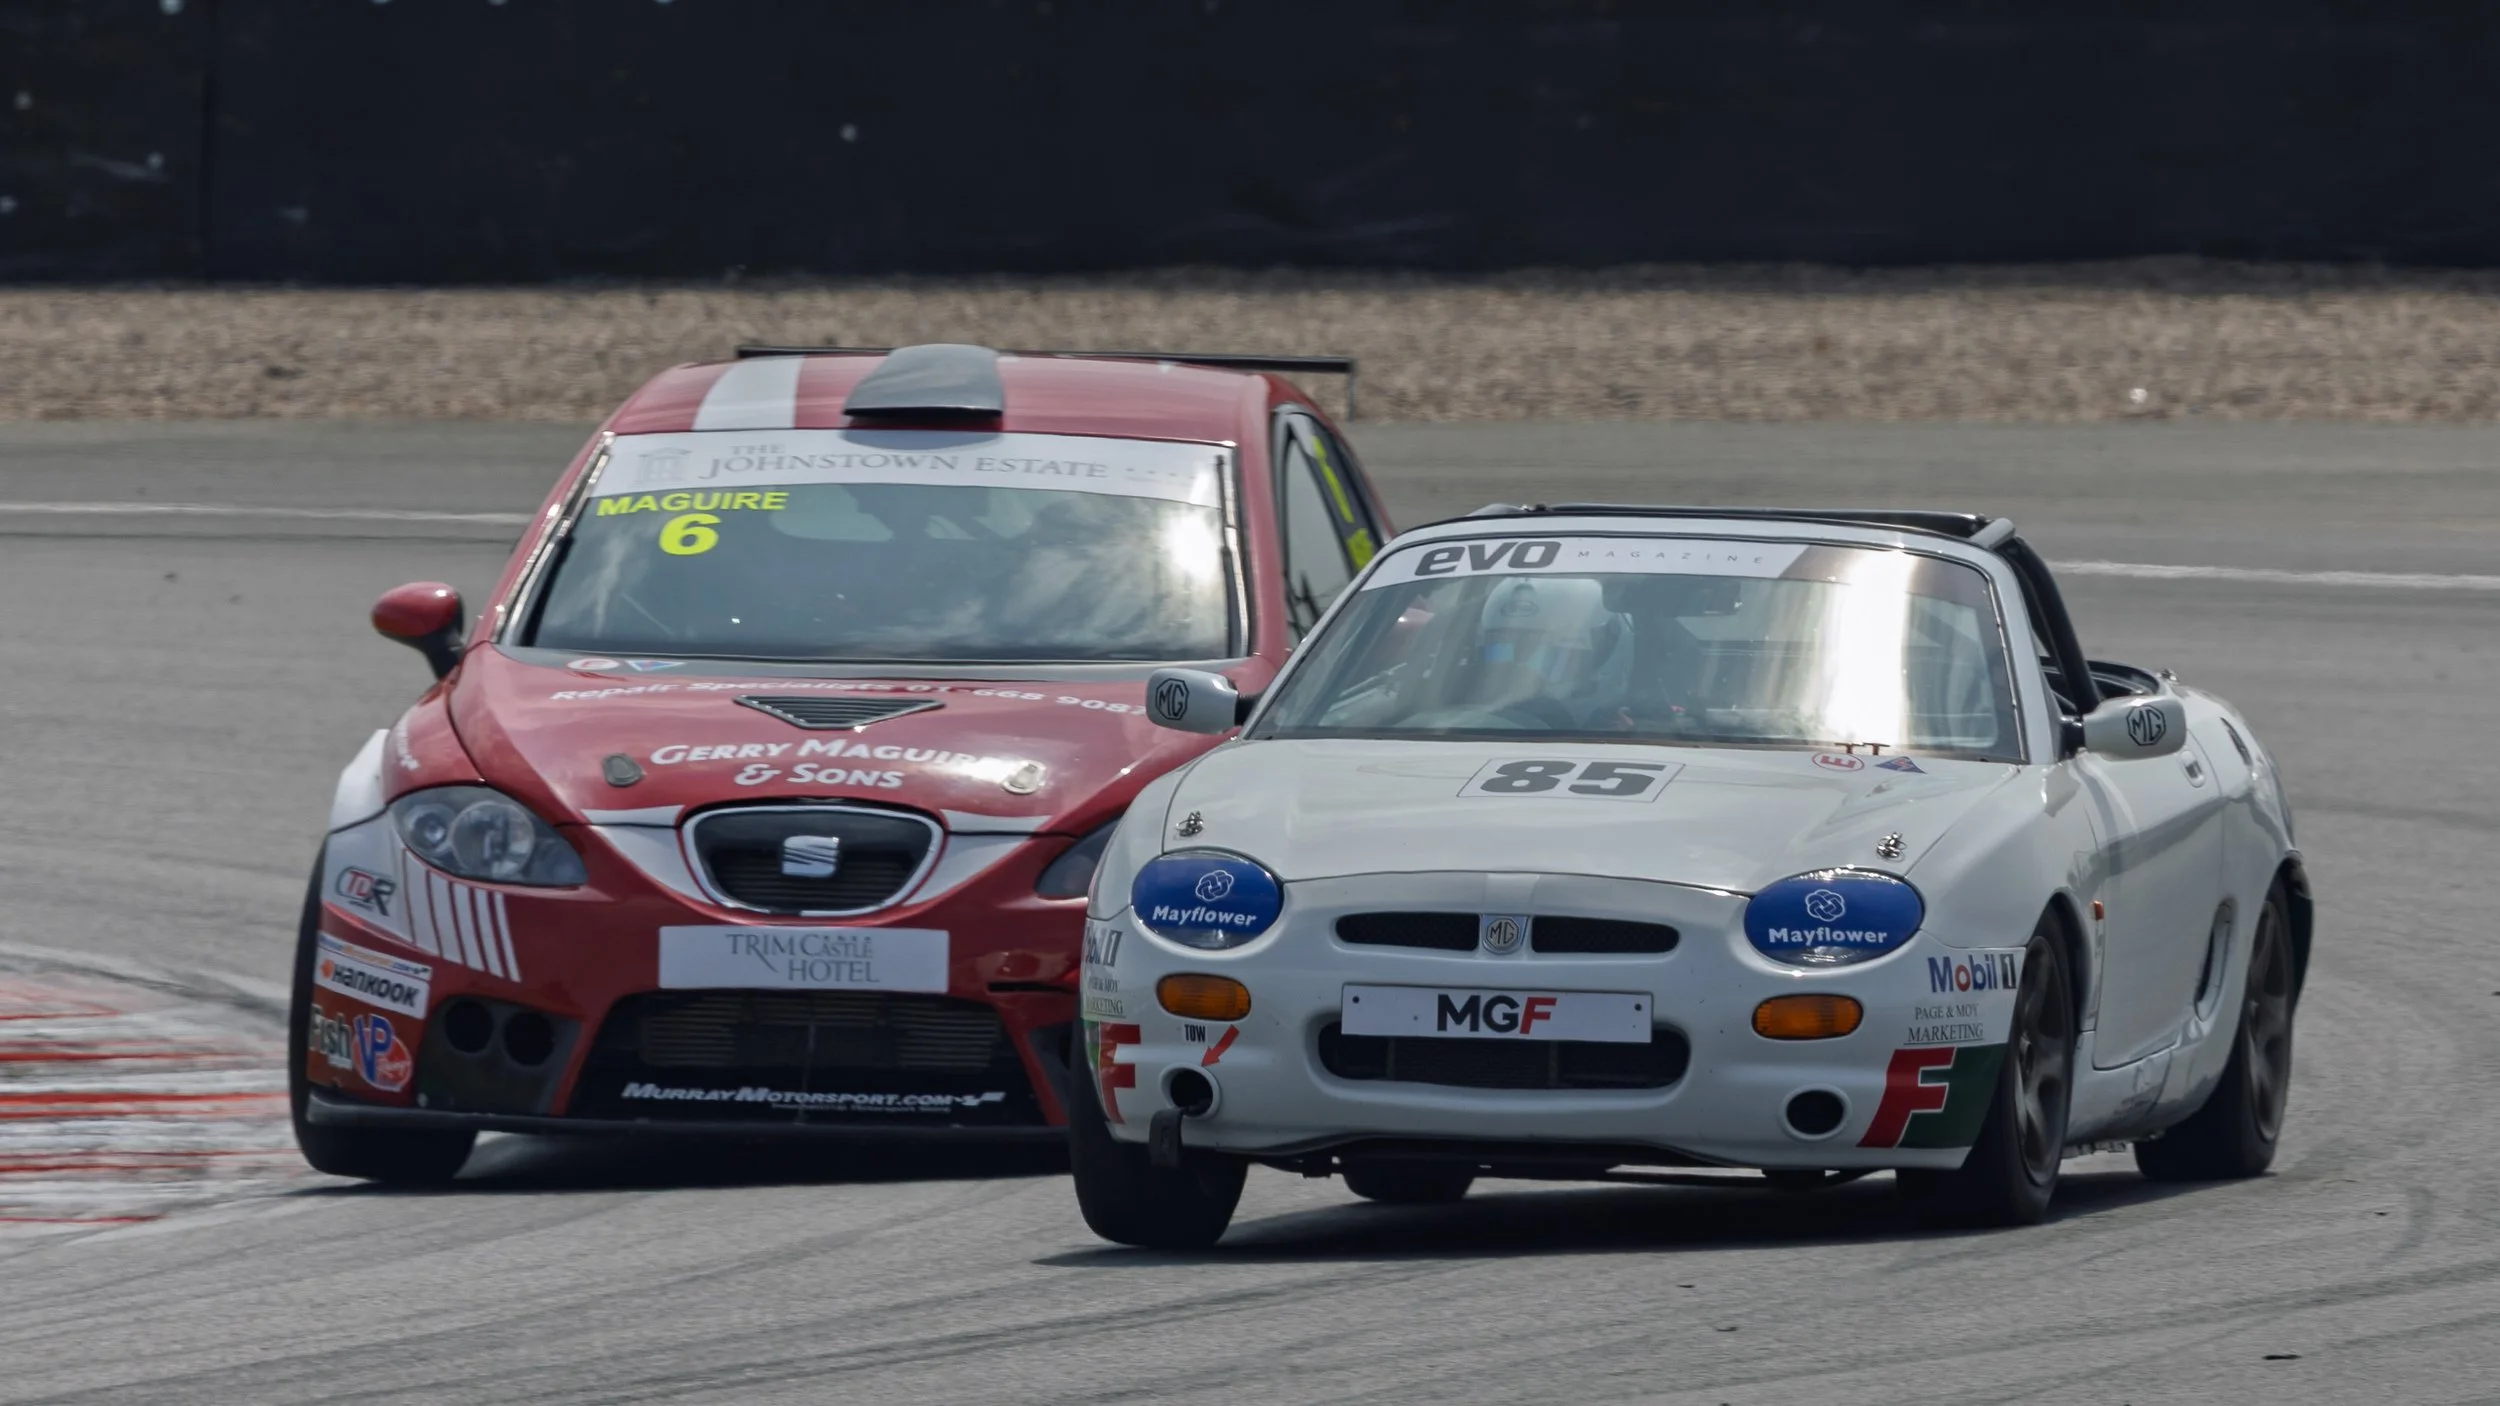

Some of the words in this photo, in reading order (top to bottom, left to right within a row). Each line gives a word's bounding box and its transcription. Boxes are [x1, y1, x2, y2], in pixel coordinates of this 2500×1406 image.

[731, 442, 786, 456] THE
[699, 453, 959, 480] JOHNSTOWN
[974, 457, 1109, 479] ESTATE
[596, 491, 790, 517] MAGUIRE
[658, 512, 723, 556] 6
[1414, 541, 1562, 577] evo
[1577, 549, 1765, 565] MAGAZINE
[550, 683, 680, 700] Repair
[686, 681, 894, 692] Specialists
[1158, 681, 1188, 717] MG
[2130, 706, 2163, 743] MG
[650, 742, 793, 766] GERRY
[797, 738, 1010, 778] MAGUIR
[734, 762, 781, 786] &
[786, 763, 906, 790] SONS
[1480, 759, 1666, 796] 85
[1152, 904, 1257, 928] Mayflower
[1488, 920, 1517, 946] MG
[1768, 927, 1888, 948] Mayflower
[725, 933, 796, 973] TRIM
[788, 958, 881, 983] HOTEL
[1927, 953, 1998, 993] Mobil
[2002, 954, 2015, 988] 1
[1437, 993, 1557, 1035] MGF
[1914, 1006, 1945, 1020] PAGE
[1946, 1005, 1955, 1019] &
[1956, 1003, 1979, 1018] MOY
[1184, 1024, 1206, 1043] TOW
[1907, 1023, 1984, 1043] MARKETING
[1855, 1046, 1957, 1149] F
